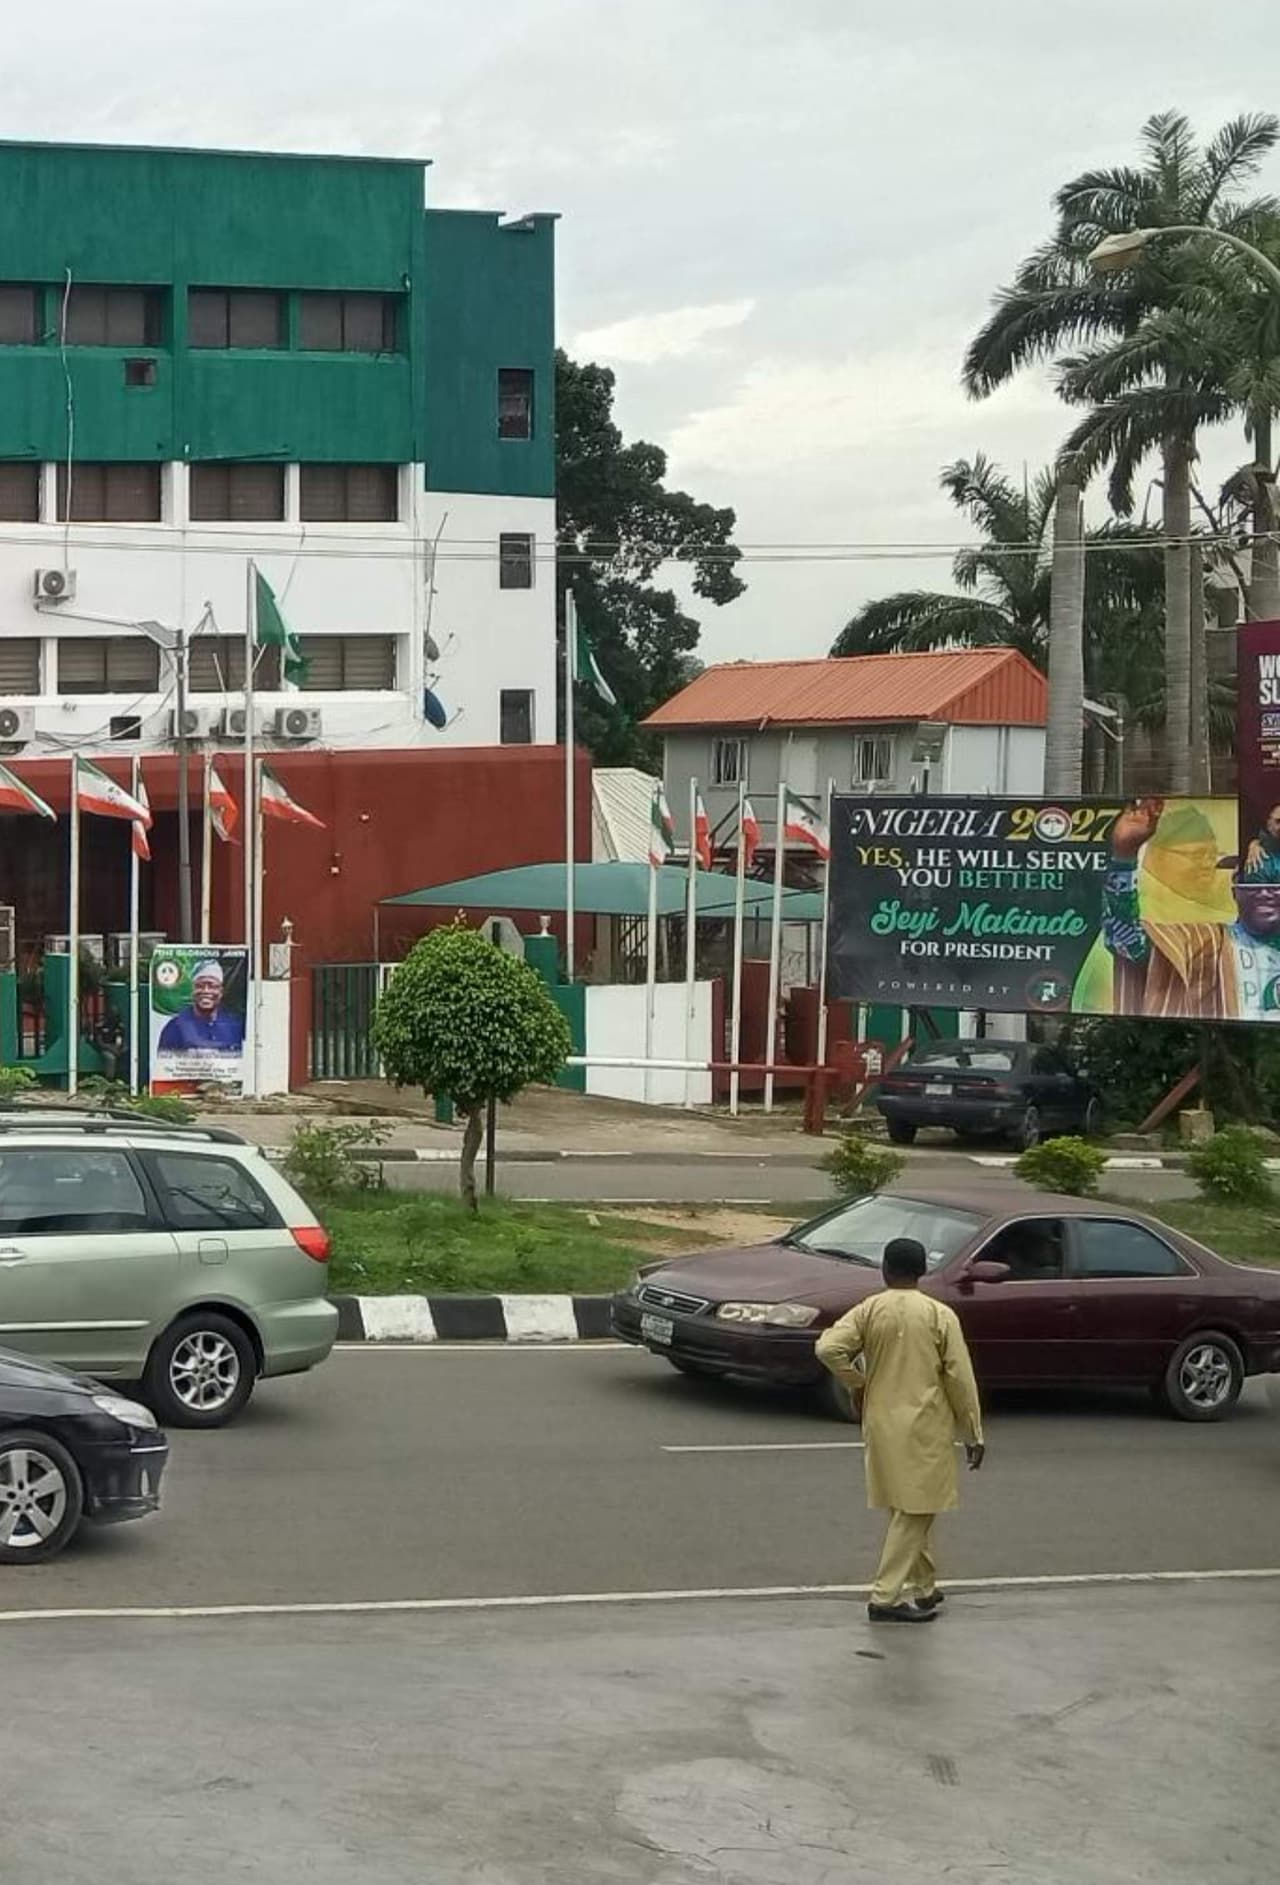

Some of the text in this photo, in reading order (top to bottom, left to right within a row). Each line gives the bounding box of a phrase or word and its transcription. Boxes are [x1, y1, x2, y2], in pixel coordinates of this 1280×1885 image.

[1259, 655, 1280, 679] W
[850, 808, 1007, 838] NIGERIA
[856, 847, 1107, 870] YES, HE WILL SERVE
[897, 868, 1063, 890] YOU BETTER!
[871, 900, 1089, 939] Seyi Makinde
[900, 940, 1056, 960] FOR PRESIDENT
[878, 980, 1011, 994] POWERED BY
